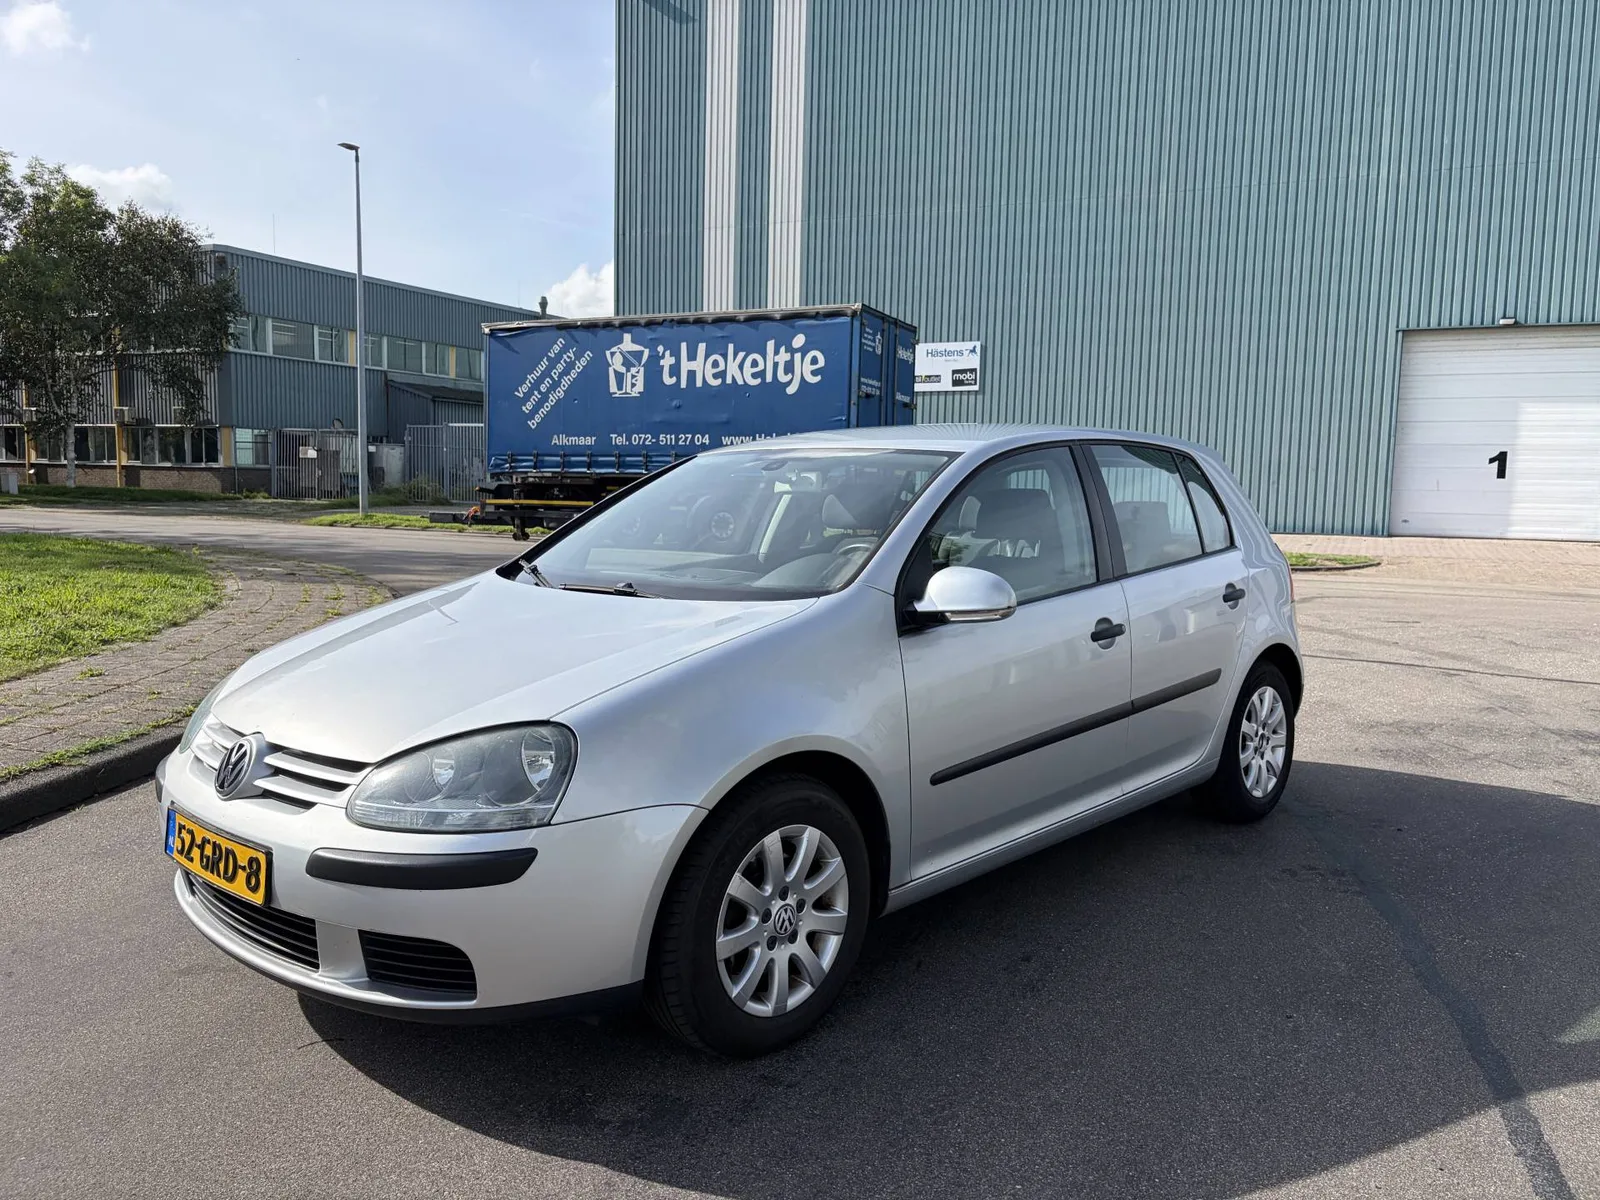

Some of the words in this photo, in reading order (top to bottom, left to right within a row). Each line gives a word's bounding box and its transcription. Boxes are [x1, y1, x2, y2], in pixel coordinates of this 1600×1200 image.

[514, 356, 549, 398] Verhuur
[547, 337, 566, 358] van
[521, 390, 542, 414] tent
[539, 377, 553, 392] en
[550, 346, 577, 380] party-
[680, 333, 825, 395] Hekeltje
[926, 348, 964, 358] Hästens
[953, 371, 975, 381] mobi
[527, 350, 593, 429] benodigdheden
[551, 434, 597, 446] Alkmaar
[610, 434, 629, 445] Tel.
[631, 434, 656, 445] 072-
[659, 434, 675, 445] 511
[678, 434, 692, 445] 27
[694, 434, 709, 445] 04
[1488, 451, 1508, 479] 1
[175, 822, 262, 895] 52-GRD-8
